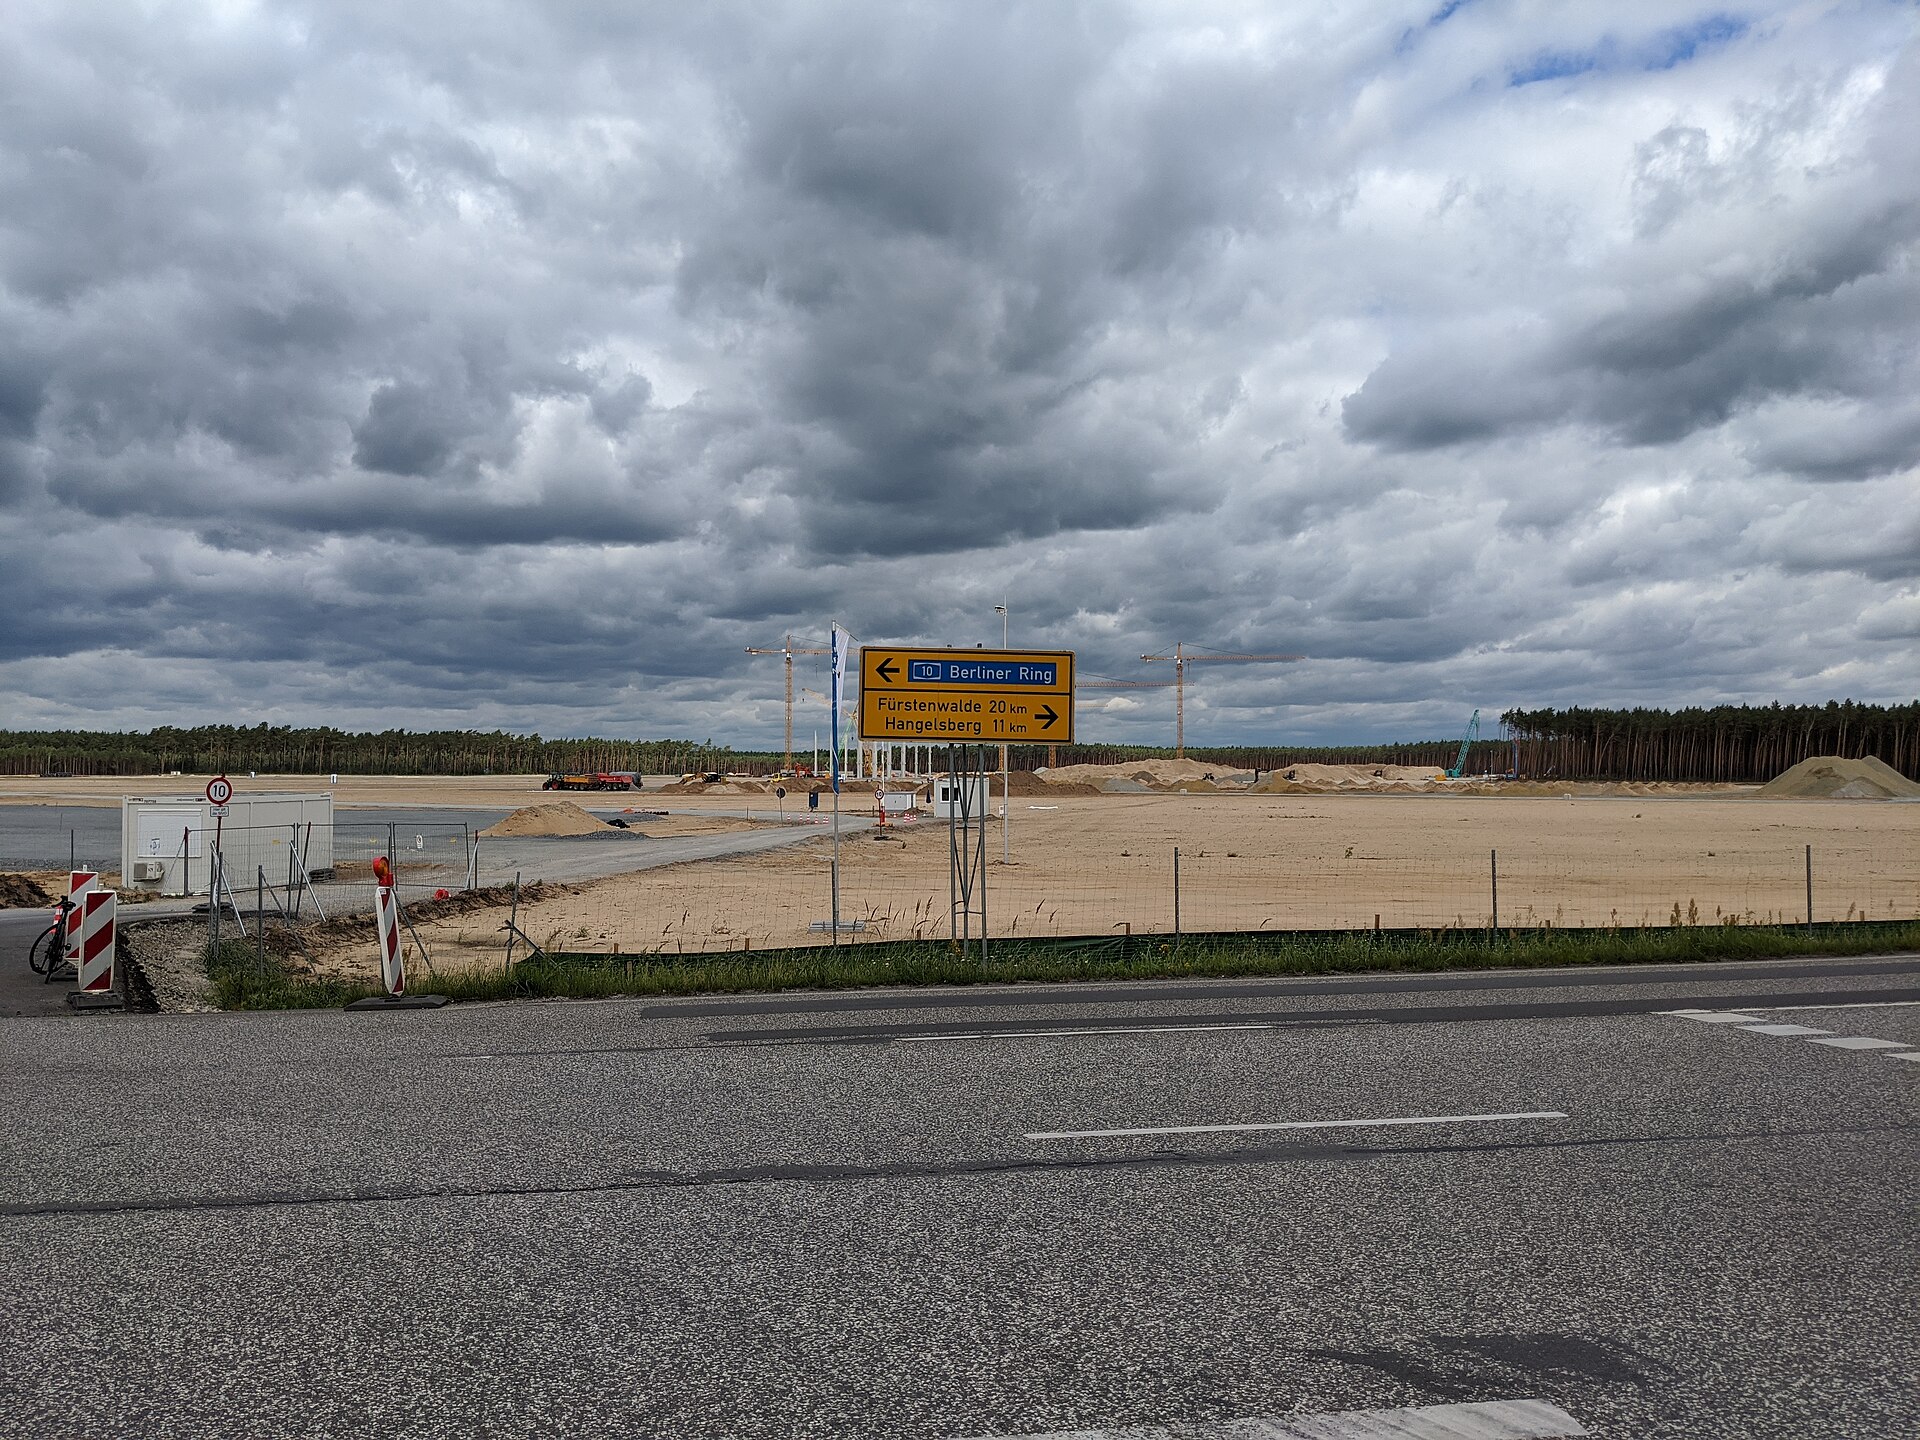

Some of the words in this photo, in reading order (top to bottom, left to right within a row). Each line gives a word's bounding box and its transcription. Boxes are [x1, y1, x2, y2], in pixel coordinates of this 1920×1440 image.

[920, 666, 933, 677] 10
[950, 665, 1012, 680] Berliner
[1019, 667, 1053, 684] Ring
[878, 697, 982, 713] Fürstenwalde
[989, 700, 1006, 713] 20
[1009, 703, 1027, 714] km
[885, 717, 982, 736] Hangelsberg
[993, 719, 1005, 732] 11
[1009, 722, 1027, 733] km
[213, 785, 226, 798] 10
